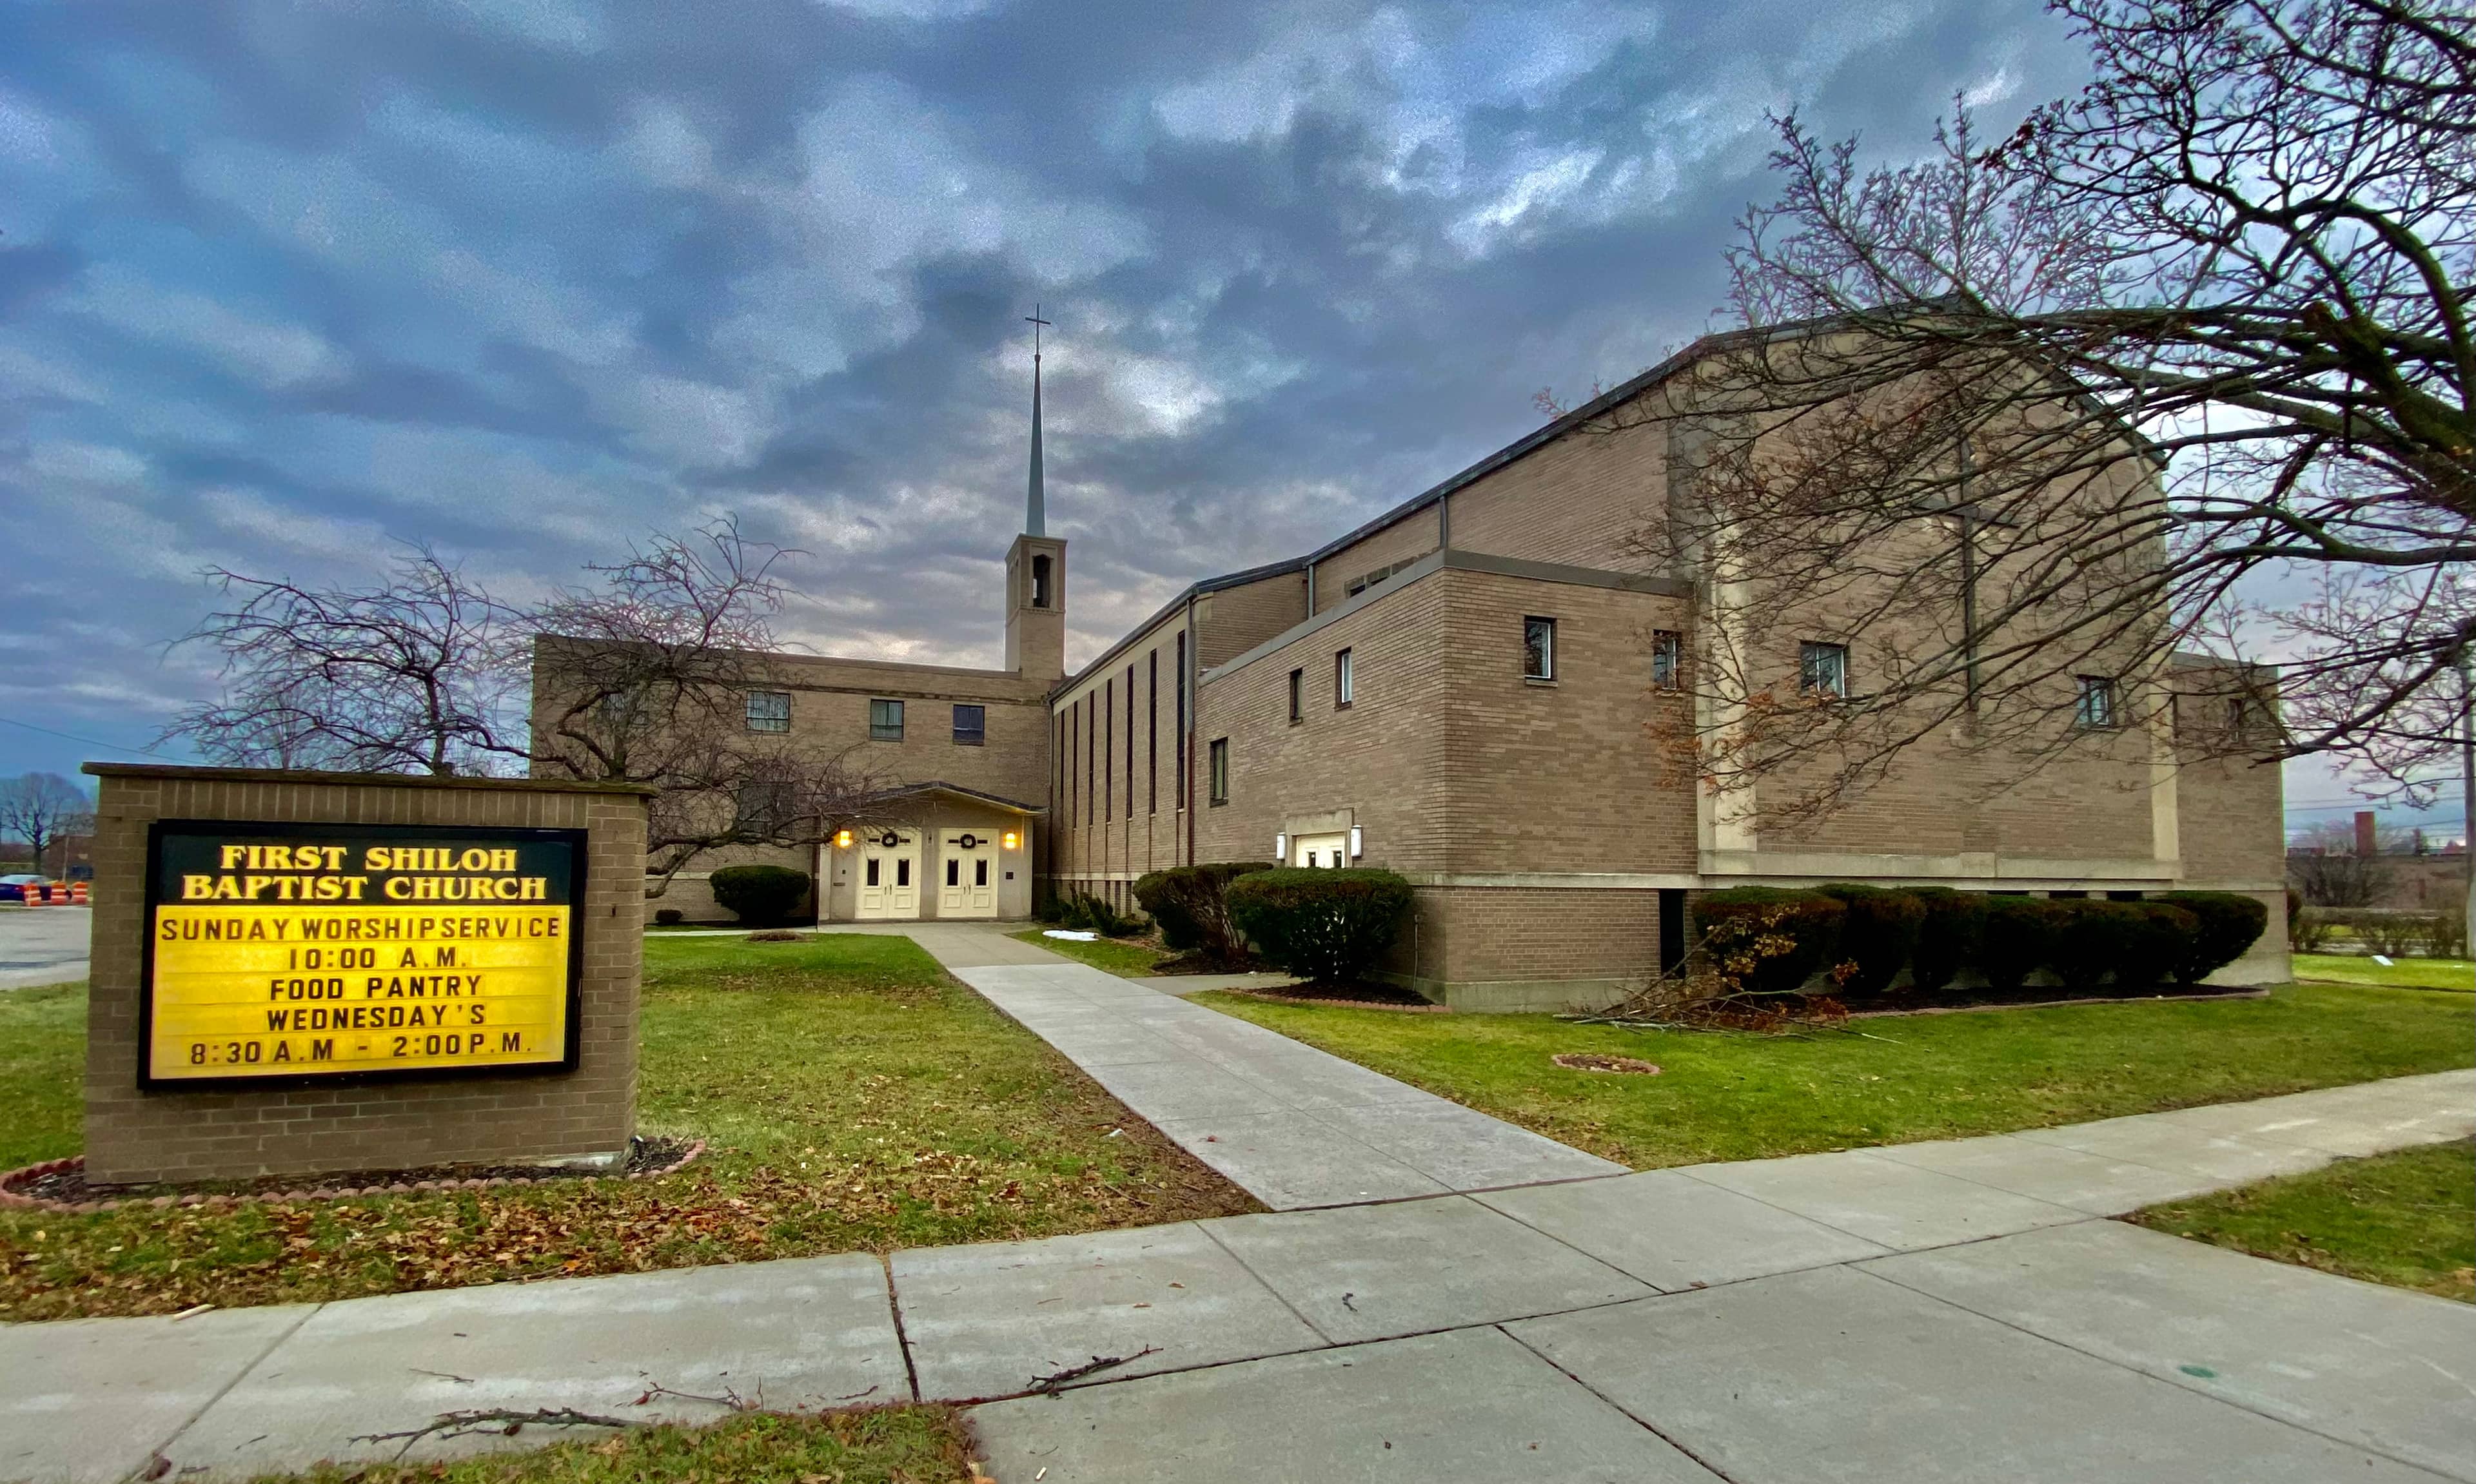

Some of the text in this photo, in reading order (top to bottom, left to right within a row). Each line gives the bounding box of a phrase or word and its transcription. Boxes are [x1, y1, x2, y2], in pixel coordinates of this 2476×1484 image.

[220, 845, 517, 872] FIRST SHILOH
[181, 874, 547, 900] BAPTIST CHURCH
[161, 918, 290, 941] SUNDAY
[290, 948, 375, 970] 10:00
[270, 975, 482, 1001] FOOD PANTRY
[267, 1004, 485, 1031] WEDNESDAY'S
[191, 1040, 261, 1064] 8:30
